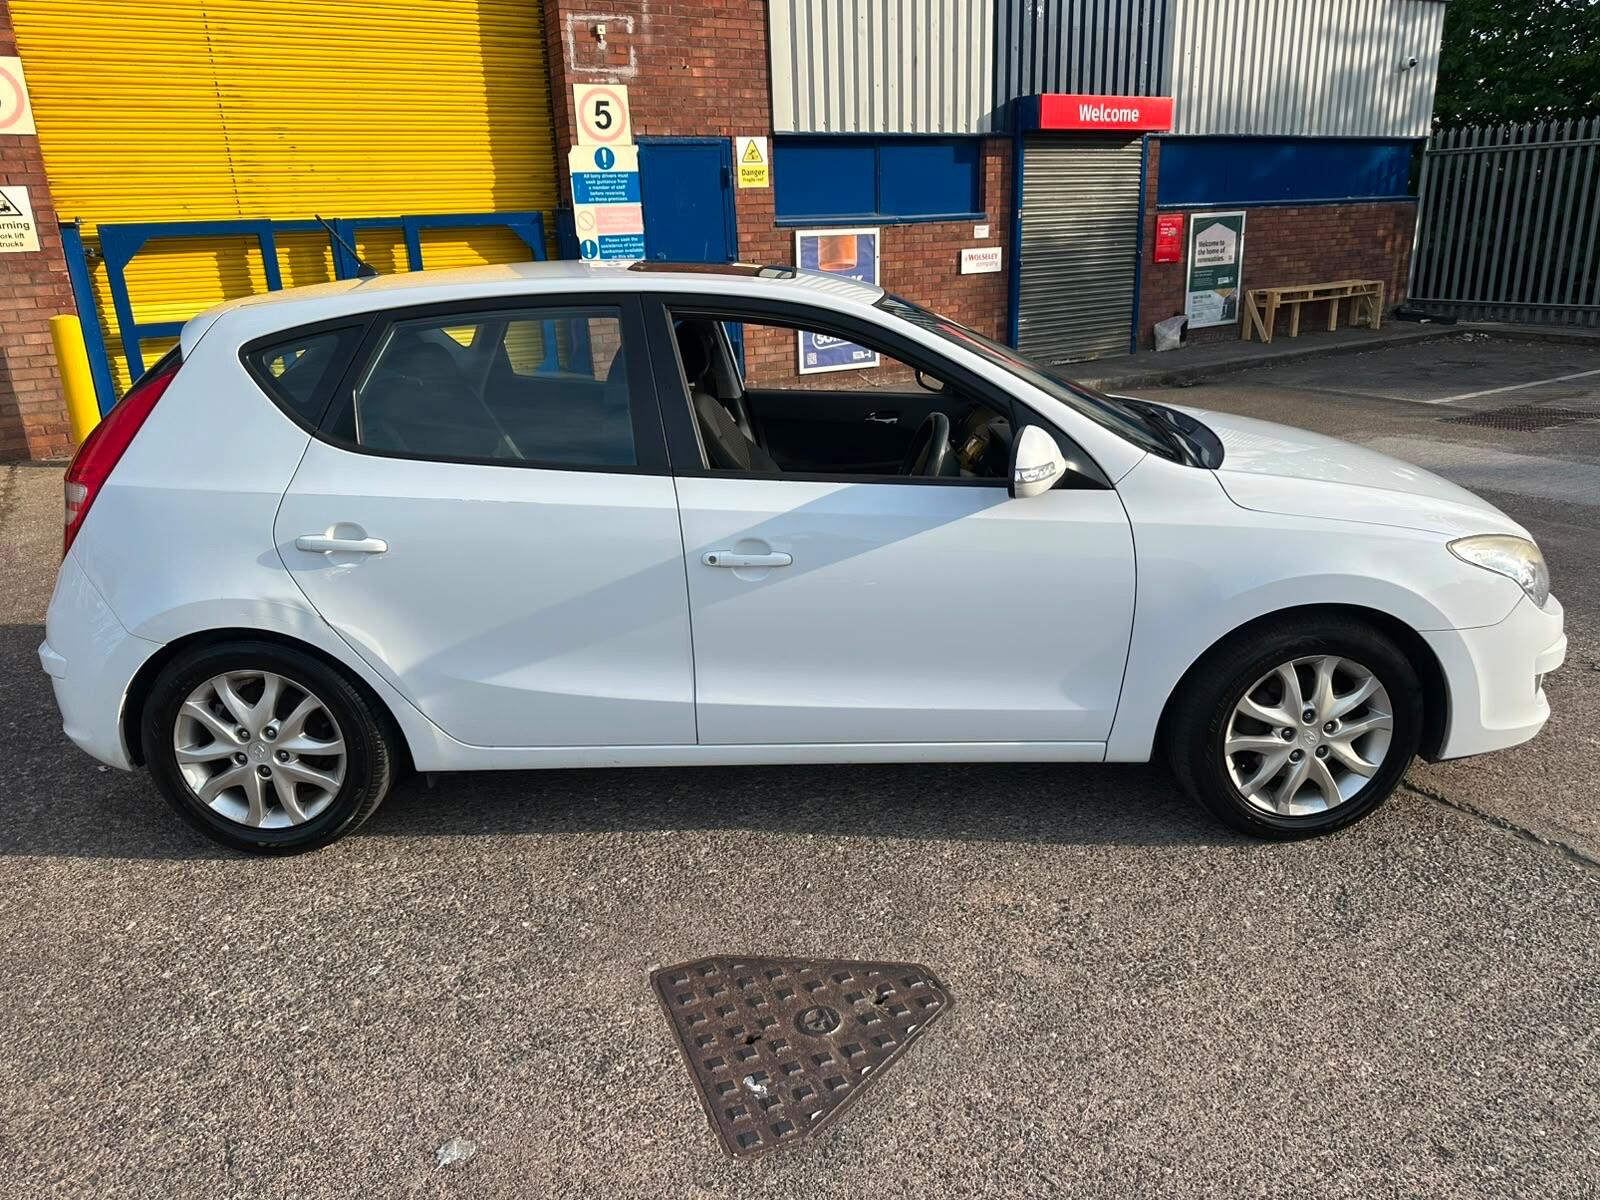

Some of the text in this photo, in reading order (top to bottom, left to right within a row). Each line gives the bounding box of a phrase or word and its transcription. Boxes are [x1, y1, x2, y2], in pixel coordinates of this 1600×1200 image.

[595, 100, 612, 130] 5
[1079, 103, 1139, 123] Welcome
[741, 169, 765, 177] Danger
[968, 252, 998, 261] WOLSELEY
